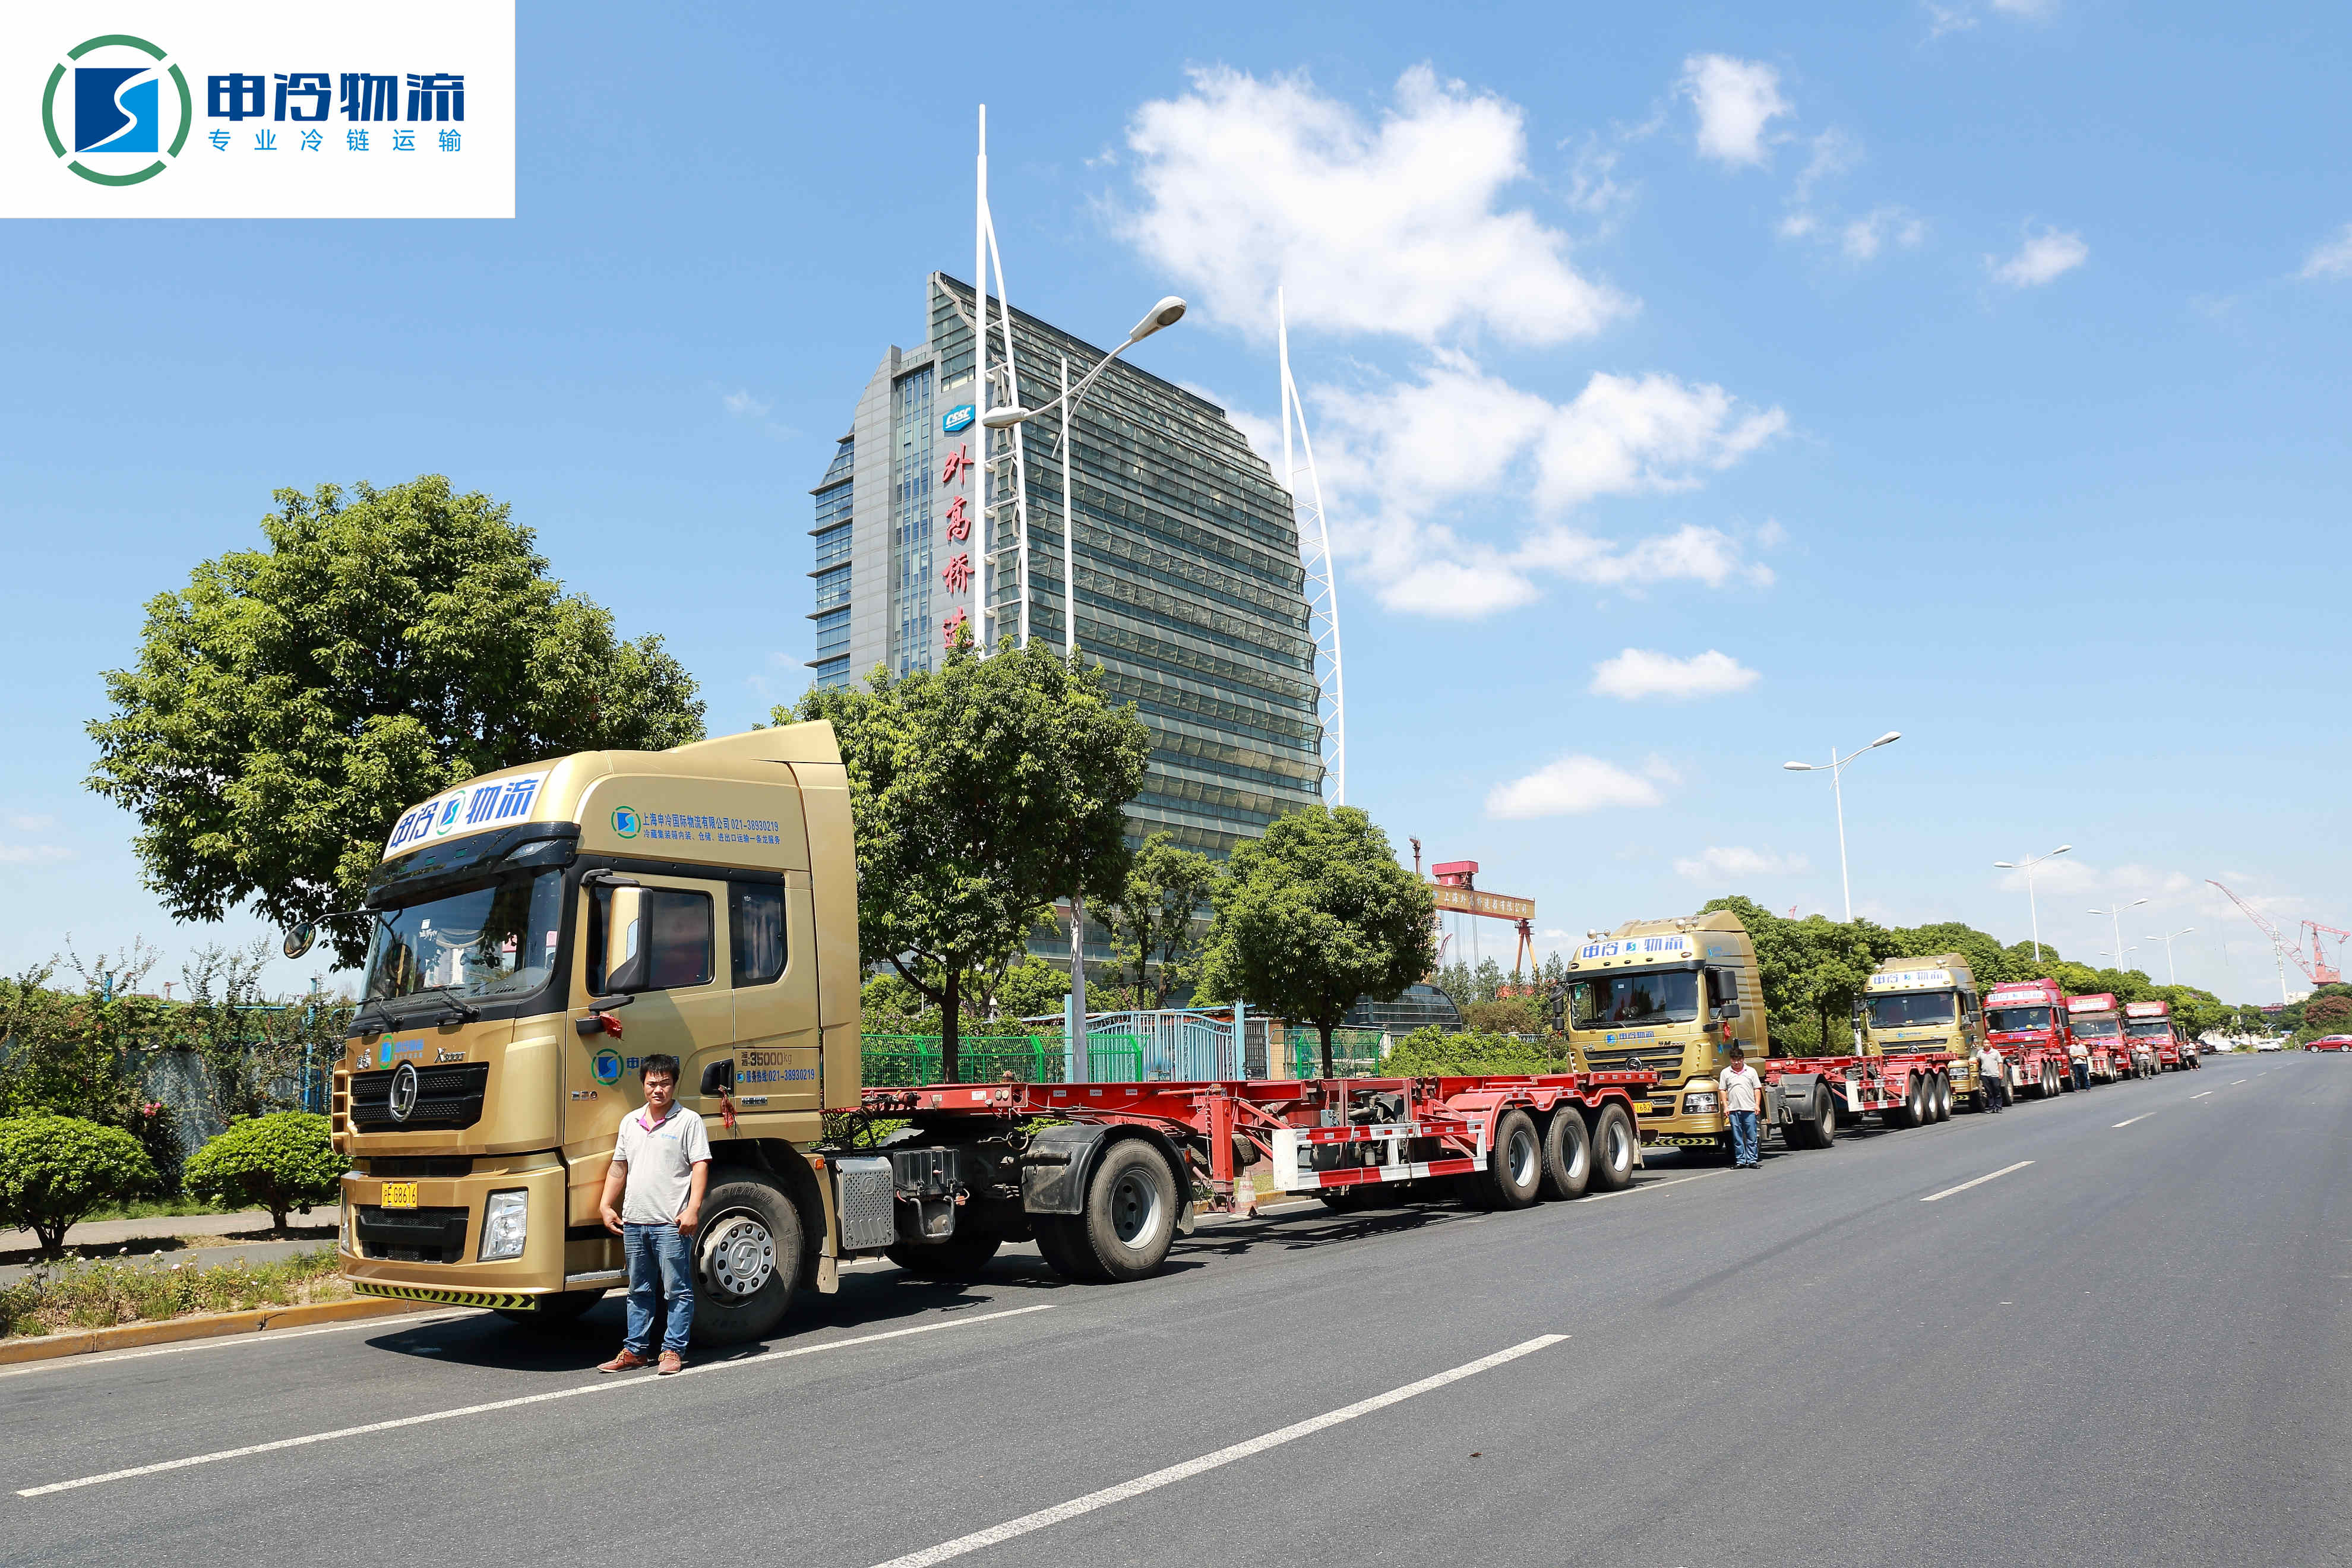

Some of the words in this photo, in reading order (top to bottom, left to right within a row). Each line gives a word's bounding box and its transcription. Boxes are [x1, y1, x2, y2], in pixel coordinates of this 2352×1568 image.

[946, 407, 971, 425] CSSC
[390, 801, 440, 848] 申冷
[466, 779, 539, 824] 物流
[643, 813, 730, 830] 上海申冷国际物流有限公司
[731, 819, 779, 832] 021-38930219
[1583, 942, 1618, 958] 申冷
[1645, 937, 1683, 951] 物流
